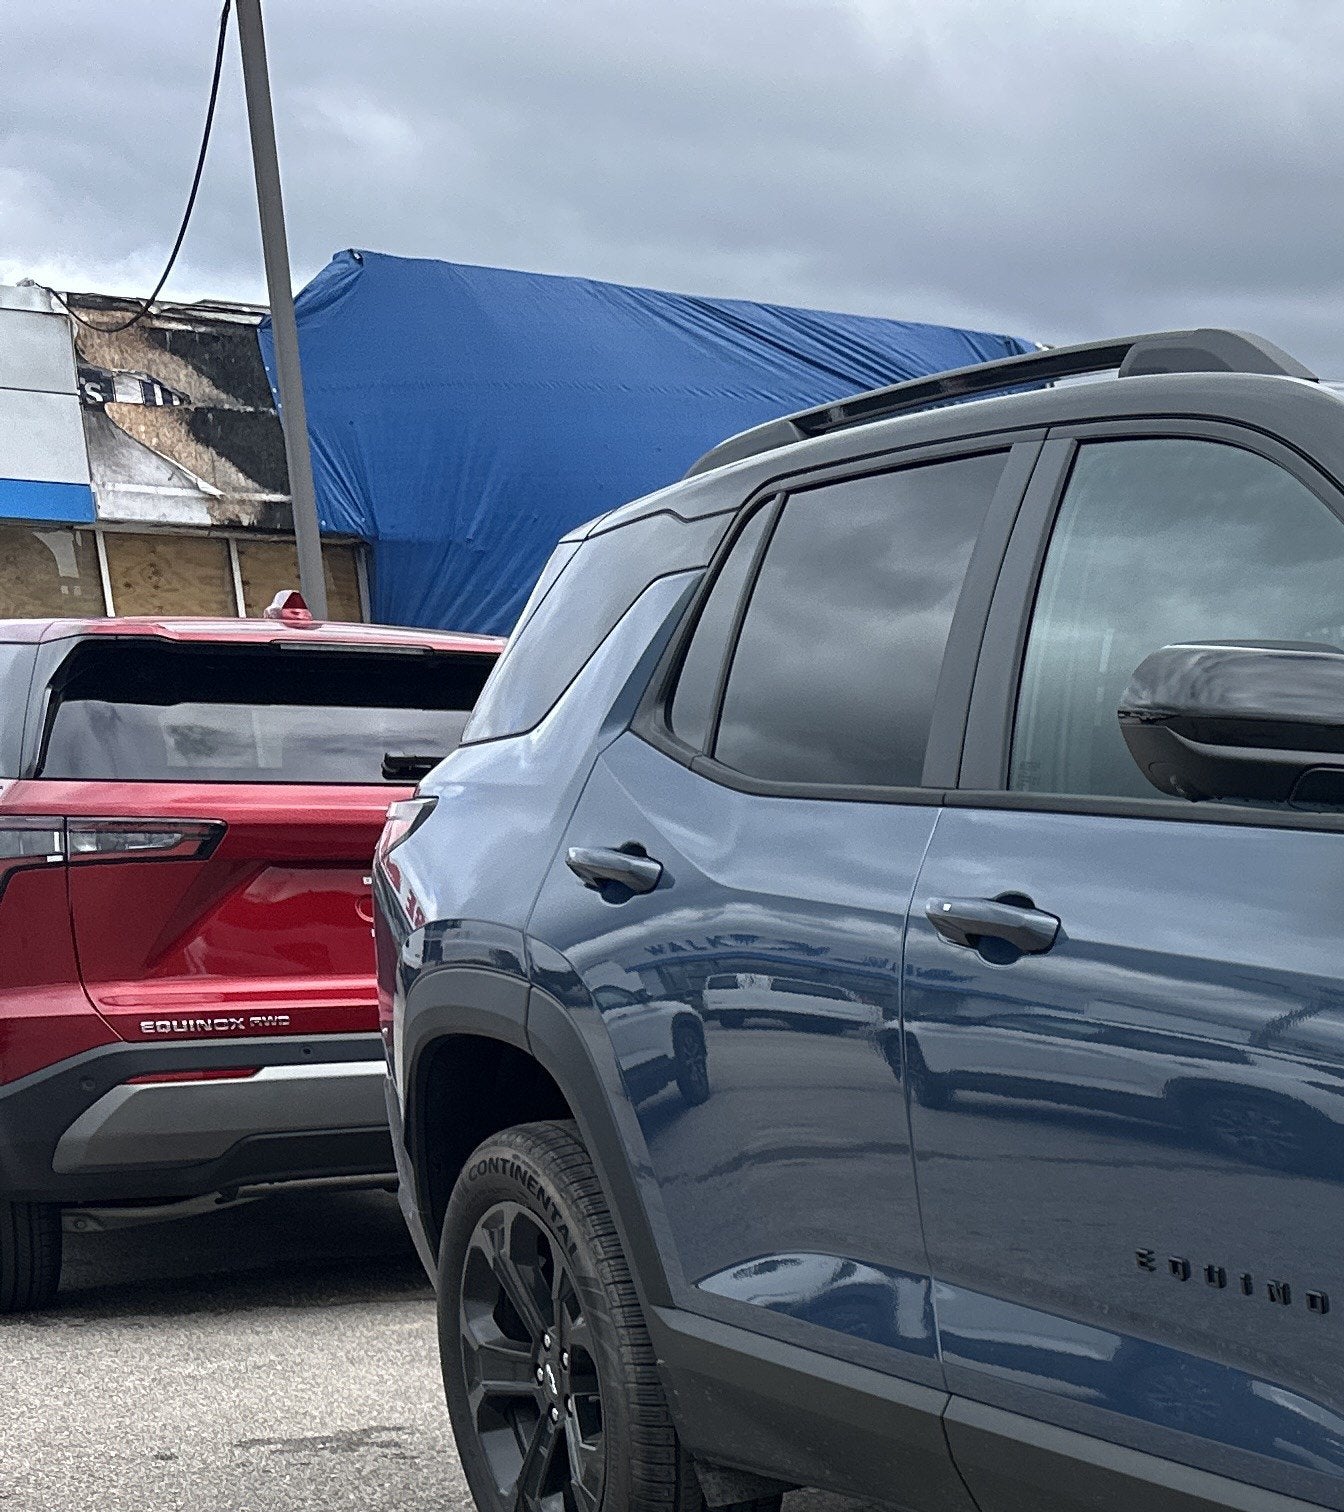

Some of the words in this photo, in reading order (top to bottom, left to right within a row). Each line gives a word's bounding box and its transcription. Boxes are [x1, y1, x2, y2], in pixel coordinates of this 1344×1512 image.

[140, 1017, 246, 1034] EQUINOX
[249, 1015, 290, 1027] AWD
[468, 1156, 578, 1258] CONTINENTAL
